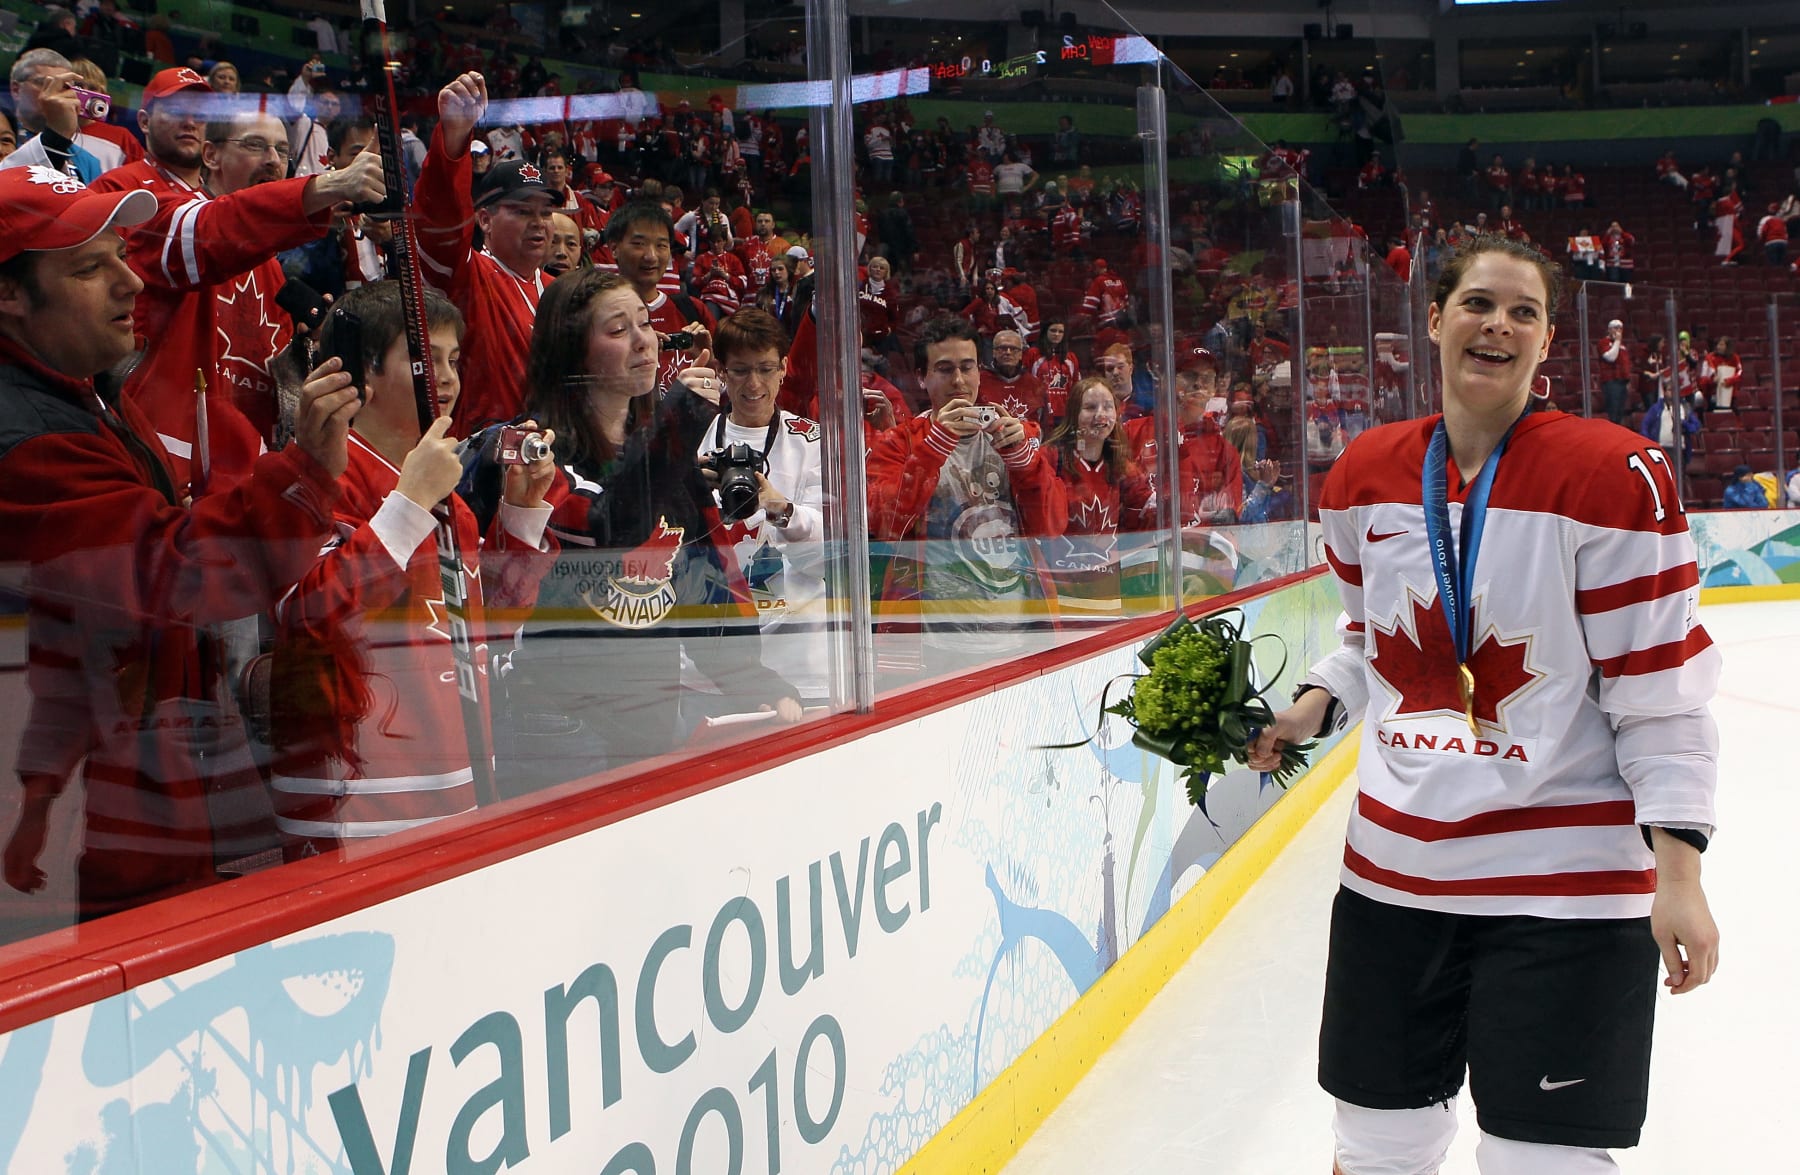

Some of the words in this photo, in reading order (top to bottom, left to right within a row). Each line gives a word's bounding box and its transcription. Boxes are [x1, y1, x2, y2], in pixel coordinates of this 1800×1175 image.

[1055, 558, 1115, 574] CANADA
[1436, 539, 1447, 568] 2010
[600, 585, 674, 625] ANADA
[1377, 730, 1529, 762] CANADA
[327, 801, 943, 1175] vancouver
[598, 1013, 847, 1175] 010
